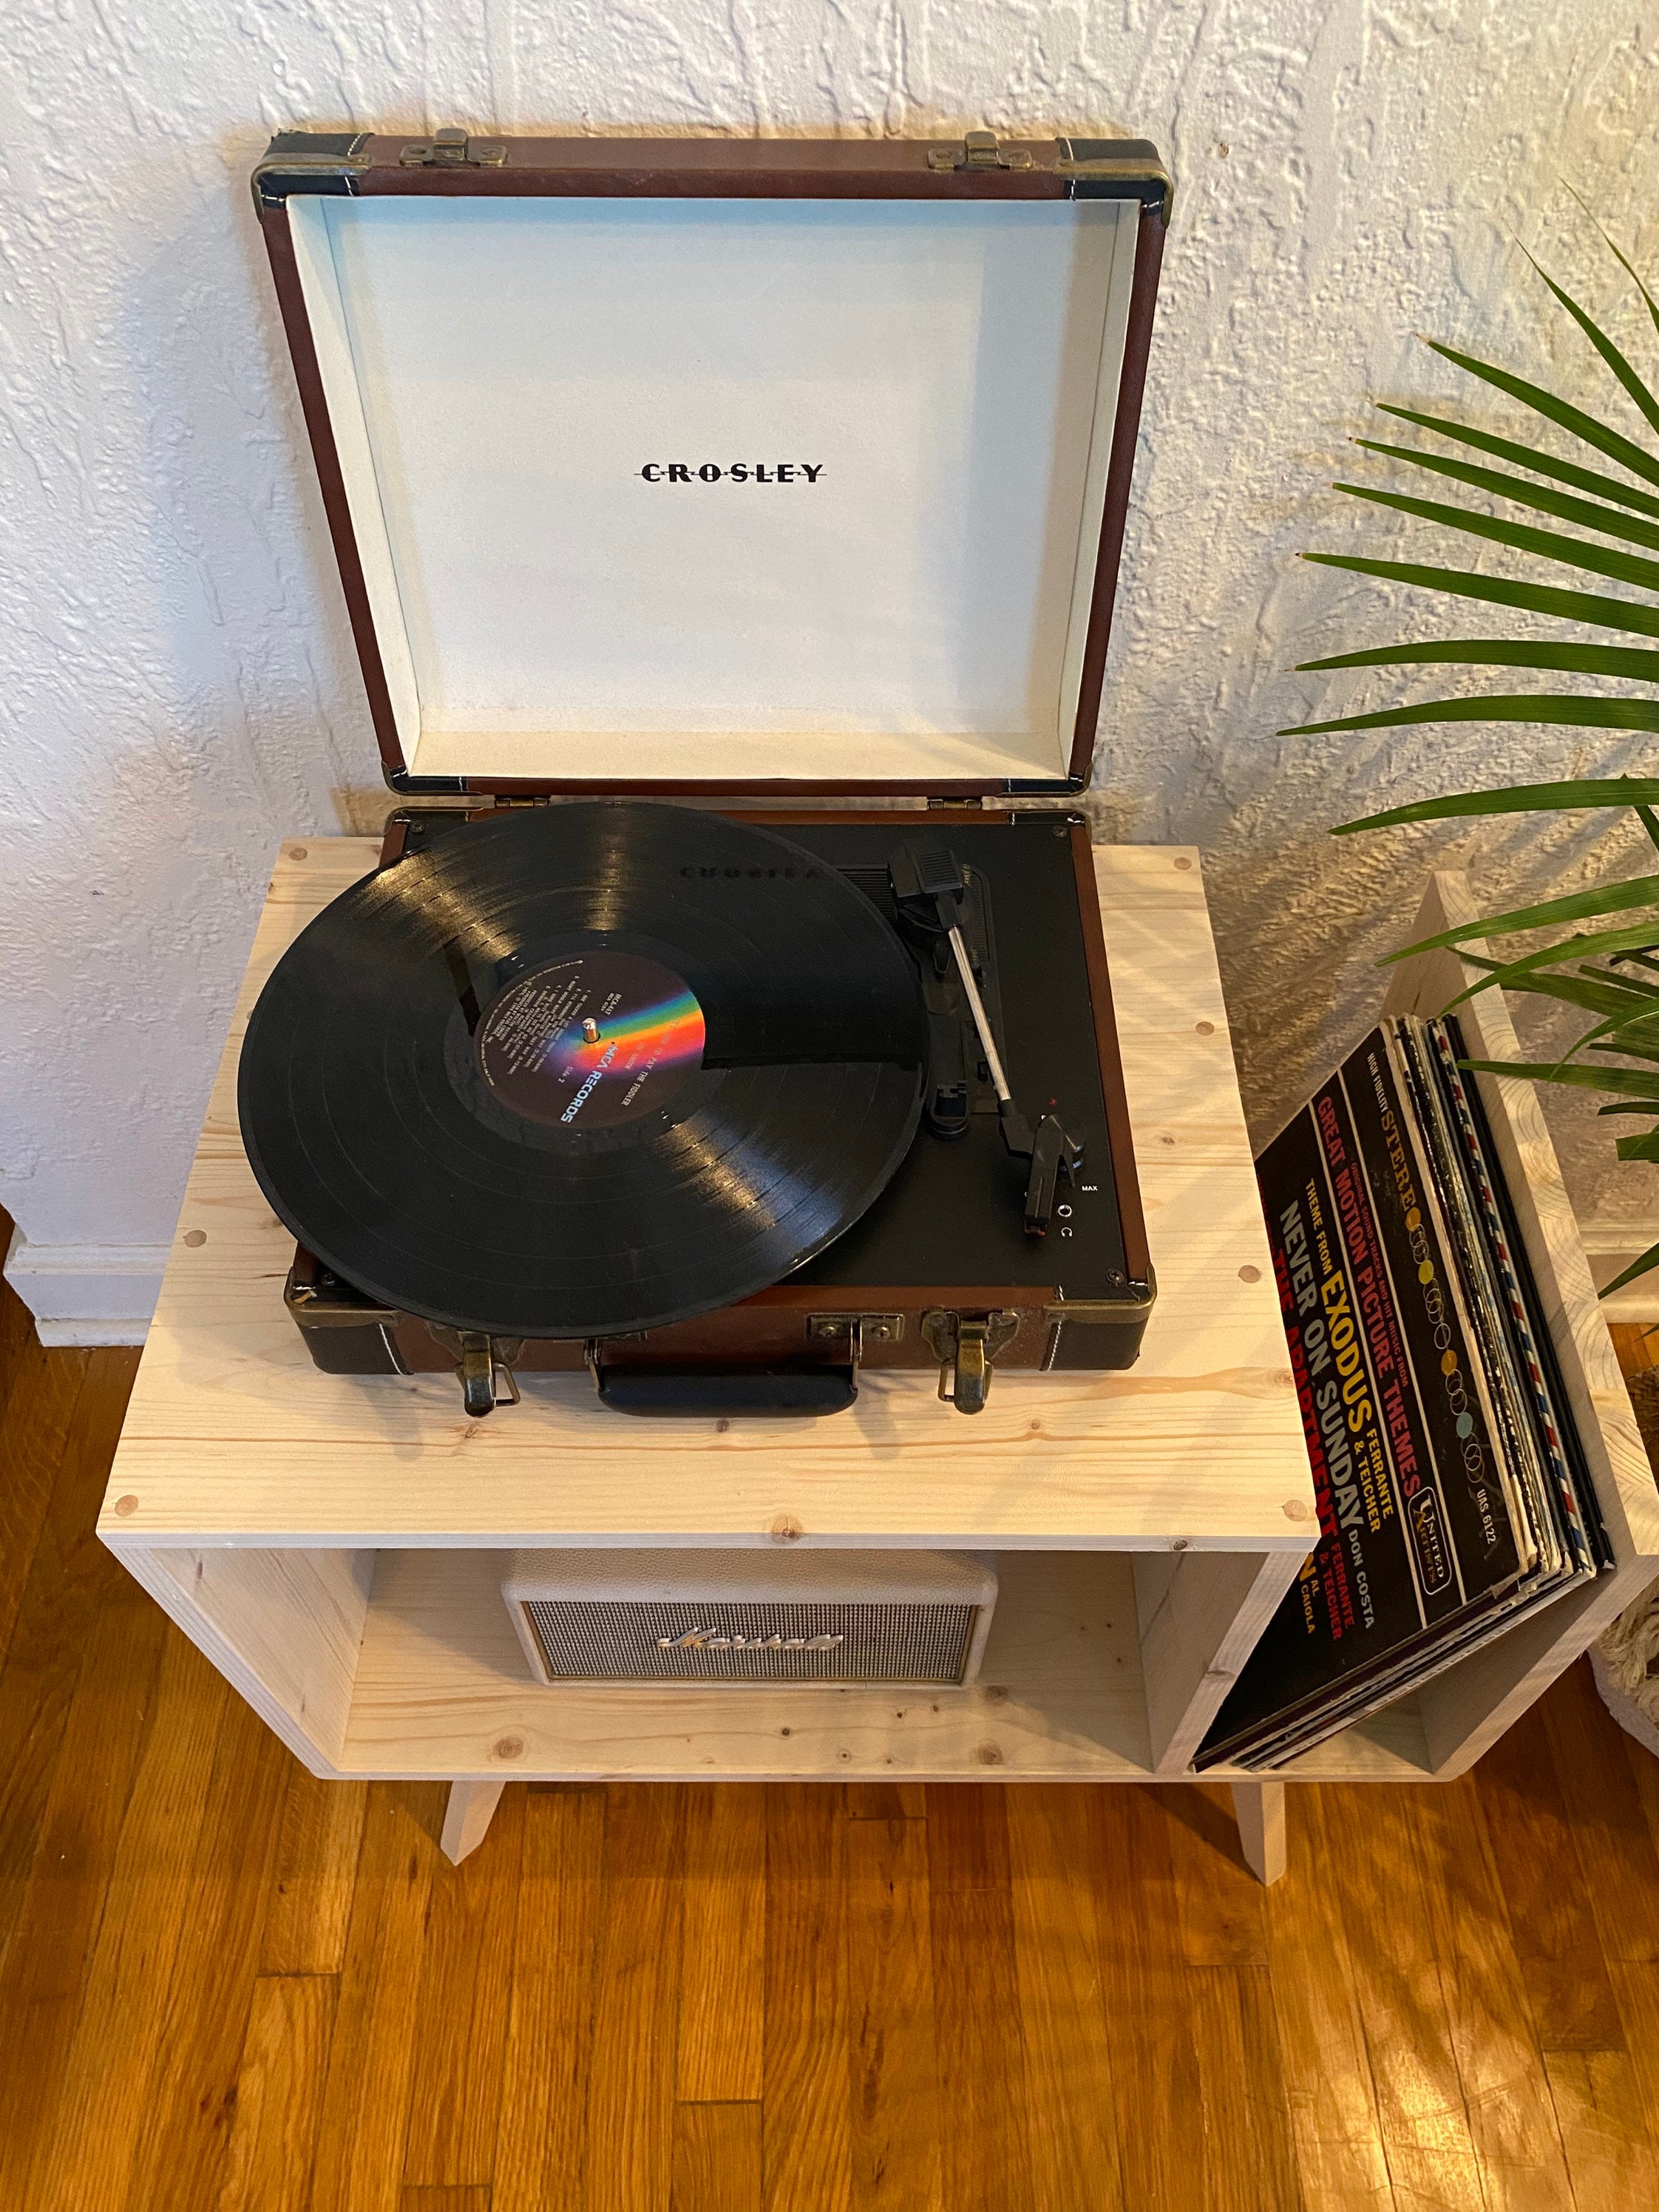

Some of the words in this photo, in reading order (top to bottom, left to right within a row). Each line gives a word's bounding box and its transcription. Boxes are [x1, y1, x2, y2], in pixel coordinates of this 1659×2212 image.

[641, 464, 824, 483] CROSLEY
[561, 1065, 573, 1077] Side
[595, 1044, 619, 1070] MCA
[636, 1070, 648, 1082] THE
[644, 1056, 657, 1069] PAY
[560, 1069, 603, 1123] RECORDS
[620, 1082, 641, 1106] FIDDLER
[1367, 1053, 1380, 1075] HIGH
[1374, 1073, 1389, 1113] FIDELITY
[1306, 1177, 1323, 1230] THEME
[1351, 1162, 1367, 1210] ORIGINAL
[1361, 1207, 1374, 1238] SOUND
[1280, 1198, 1318, 1317] NEVER
[1315, 1230, 1334, 1275] FROM
[1369, 1237, 1383, 1278] TRACKS
[1317, 1096, 1346, 1167] GREAT
[1334, 1168, 1368, 1266] MOTION
[1358, 1266, 1394, 1379] PICTURE
[1383, 1378, 1421, 1497] THEMES
[1379, 1280, 1388, 1301] AND
[1383, 1297, 1392, 1319] HIT
[1304, 1318, 1331, 1377] ON
[1320, 1269, 1373, 1433] EXODUS
[1388, 1320, 1400, 1355] MUSIC
[1396, 1356, 1409, 1388] FROM
[1316, 1380, 1365, 1530] SUNDAY
[1353, 1440, 1365, 1455] &
[1357, 1456, 1382, 1533] TEICHER
[1366, 1427, 1394, 1520] FERRANTE
[1476, 1488, 1489, 1513] UAS
[1420, 1494, 1445, 1578] UNITED
[1482, 1515, 1496, 1545] 6122
[1319, 1552, 1329, 1567] &
[1348, 1528, 1363, 1567] DON
[1356, 1570, 1375, 1629] COSTA
[1310, 1579, 1320, 1598] AL
[1323, 1567, 1343, 1641] TEICHER
[1331, 1541, 1355, 1629] FERRANTE
[1300, 1584, 1316, 1635] CAIOLA
